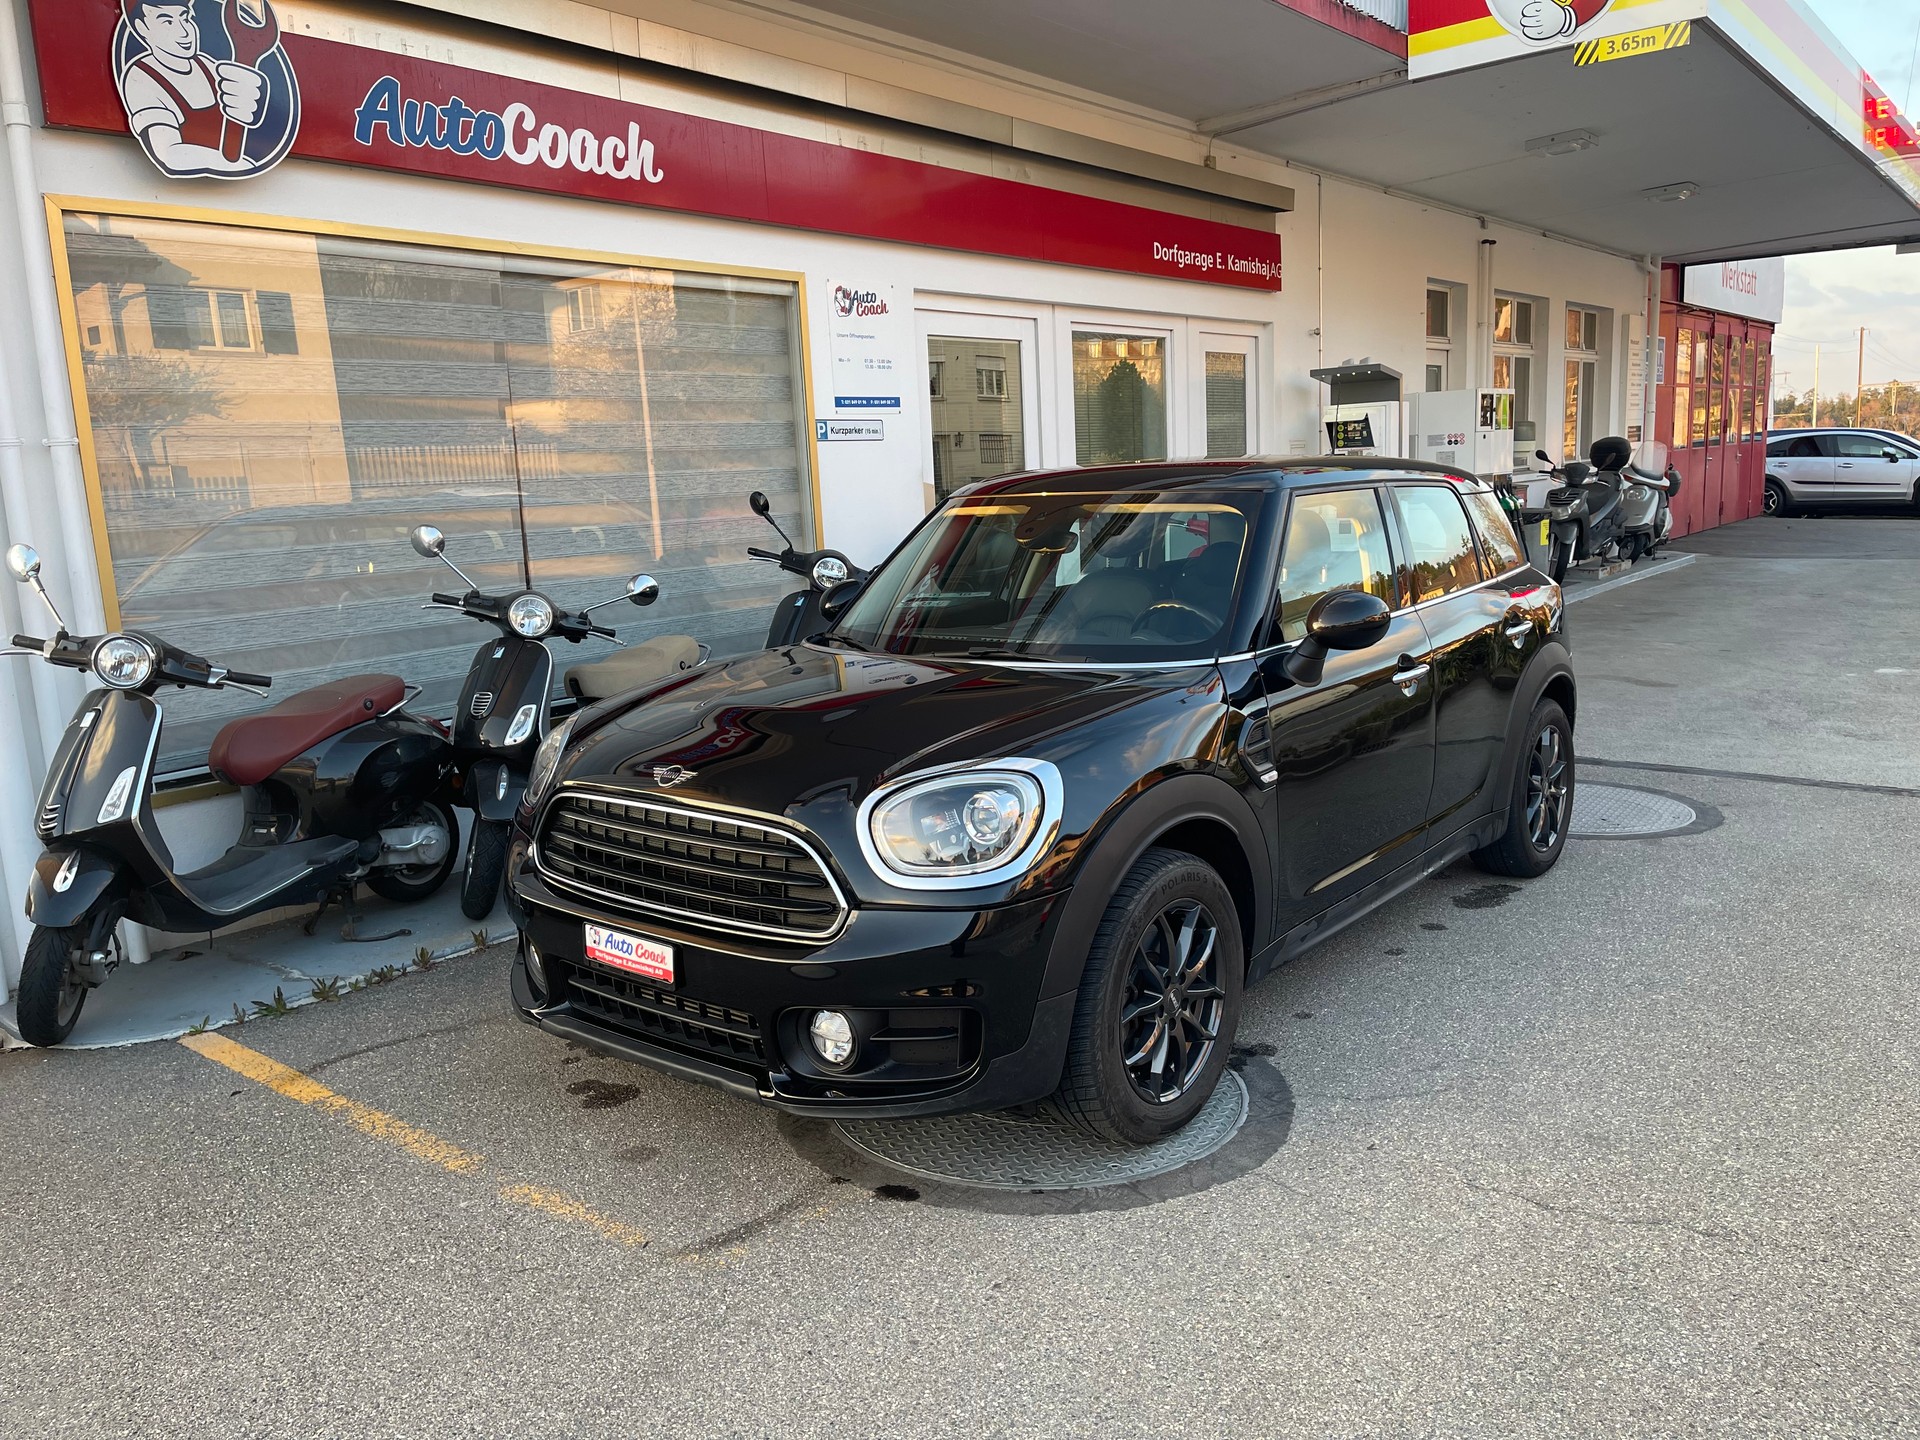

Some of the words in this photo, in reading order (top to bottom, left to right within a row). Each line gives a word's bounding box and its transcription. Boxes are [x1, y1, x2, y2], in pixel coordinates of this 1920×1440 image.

[1606, 35, 1656, 55] 3.65m
[1153, 241, 1214, 271] Dorfgarage
[1216, 252, 1225, 270] E.
[1721, 262, 1757, 297] Werkstatt
[852, 289, 877, 307] Auto
[856, 299, 890, 317] Coach
[816, 422, 826, 439] P
[830, 426, 864, 436] Kurzparker
[1161, 872, 1201, 895] POLARIS
[594, 950, 623, 966] Dorfgarage
[604, 933, 633, 956] Auto
[635, 943, 667, 965] Coach
